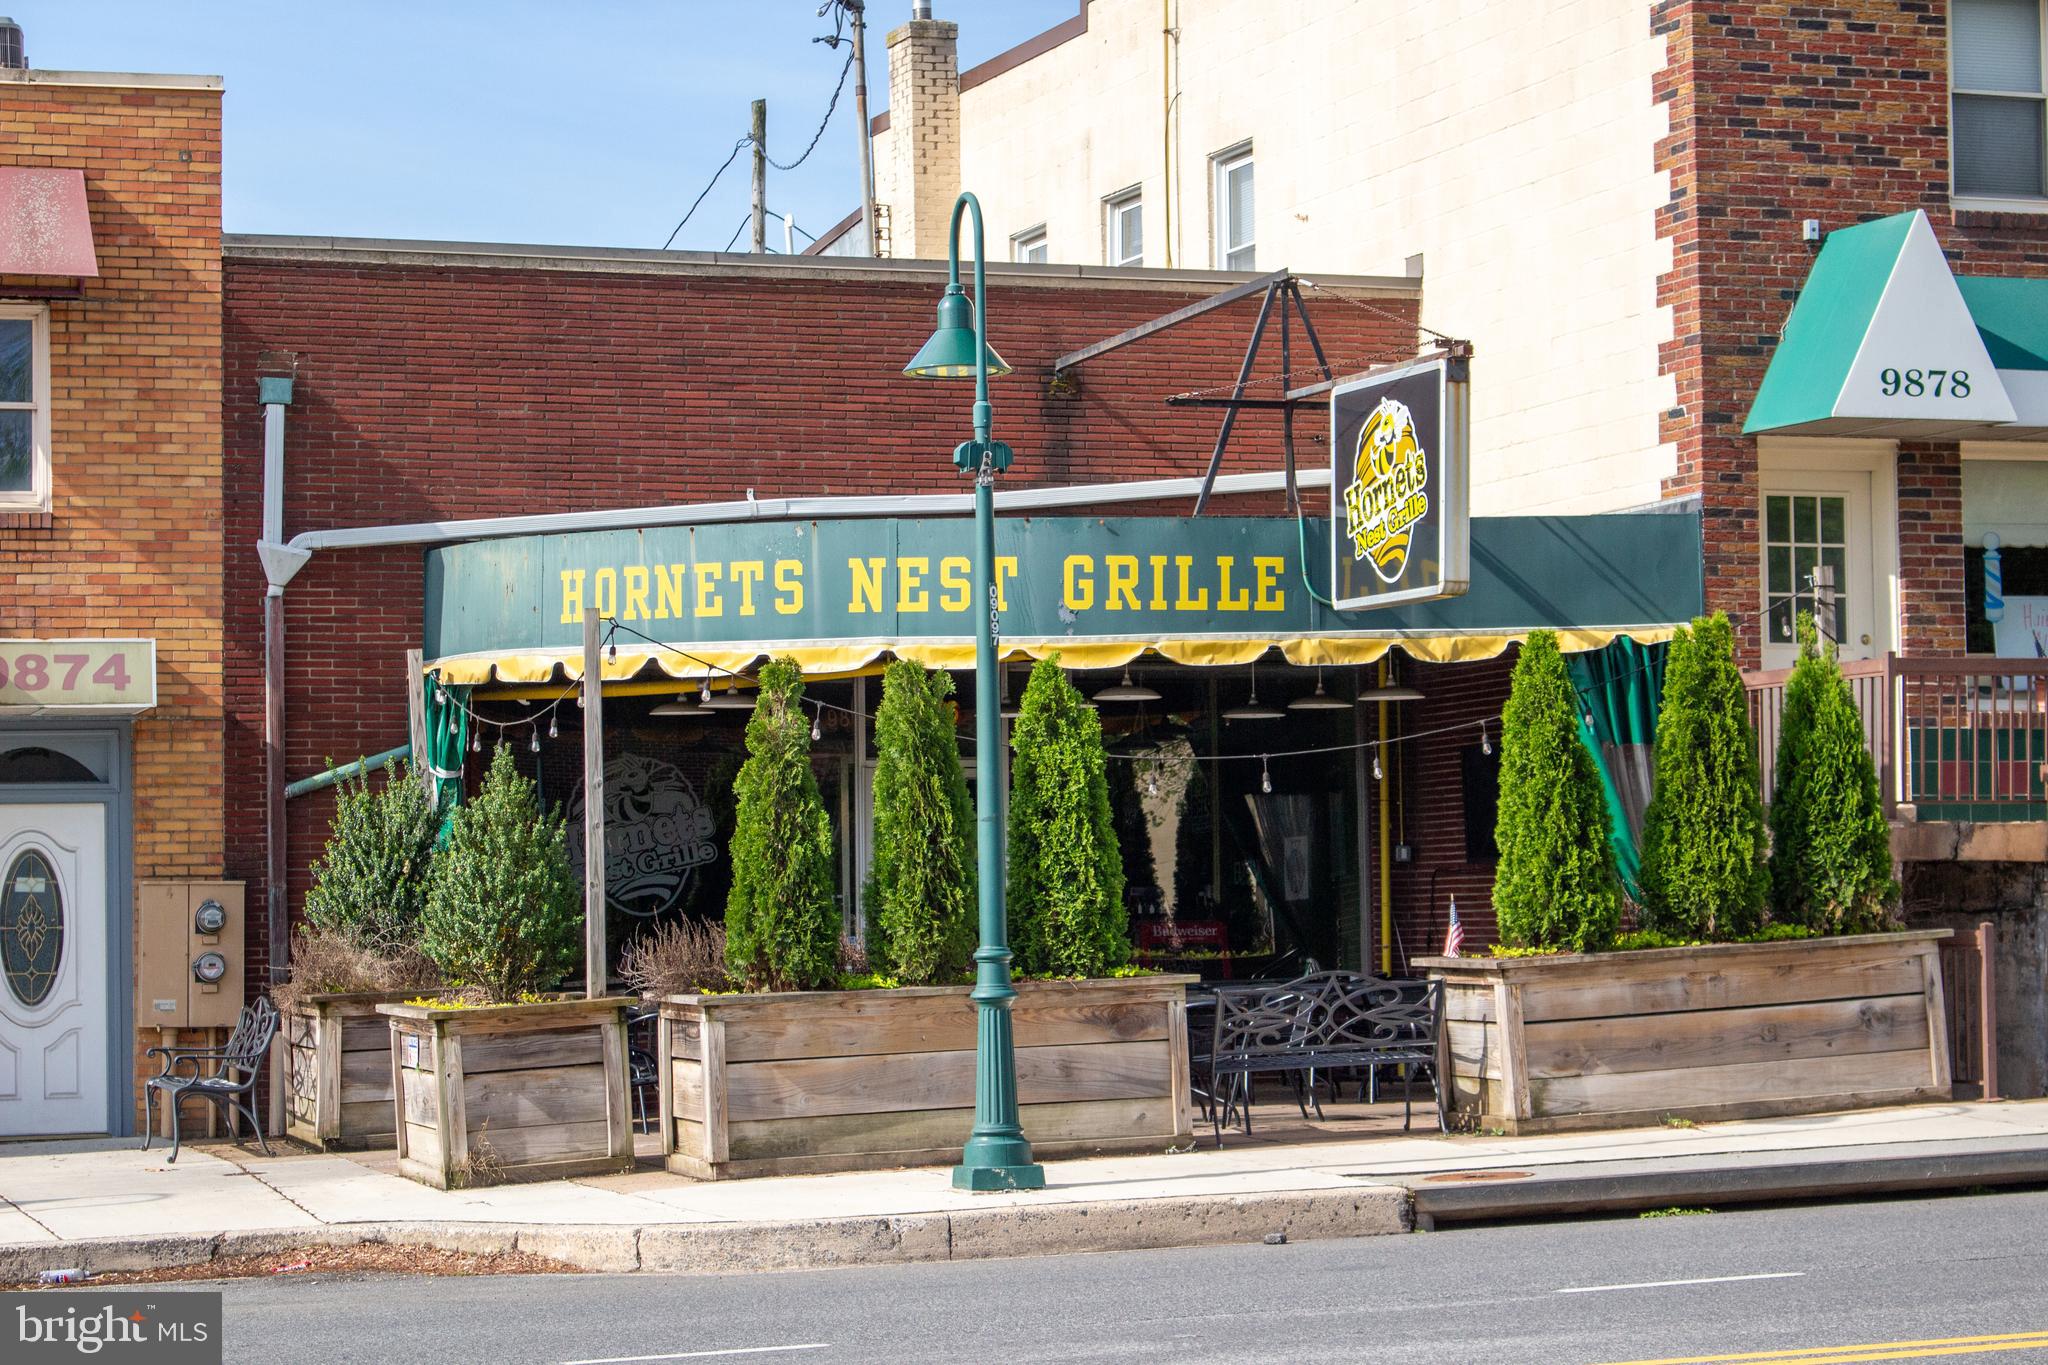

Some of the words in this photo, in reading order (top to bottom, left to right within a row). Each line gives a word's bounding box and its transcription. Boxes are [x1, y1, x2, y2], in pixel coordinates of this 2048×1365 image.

[1880, 367, 1971, 399] 9878
[1355, 519, 1386, 557] Nest
[1387, 493, 1427, 533] Grille
[560, 558, 804, 624] HORNETS
[847, 556, 1018, 612] NEST
[1063, 554, 1285, 612] GRILLE
[990, 585, 999, 646] 09097
[0, 653, 131, 691] 874
[638, 839, 715, 873] Grille
